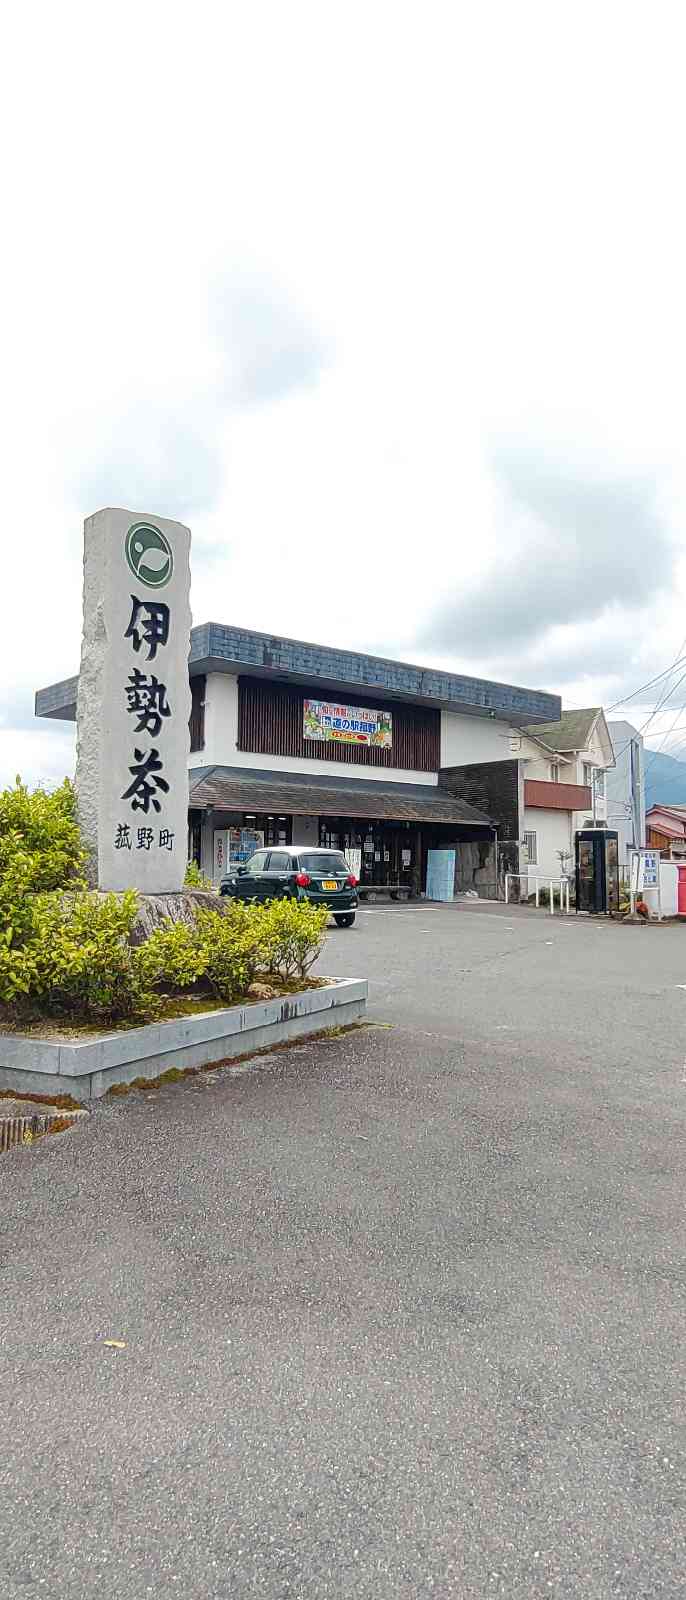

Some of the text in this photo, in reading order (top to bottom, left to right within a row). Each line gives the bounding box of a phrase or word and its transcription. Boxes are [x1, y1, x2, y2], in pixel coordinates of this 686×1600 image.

[121, 594, 172, 815] 伊勢茶
[114, 823, 175, 851] 菰野町
